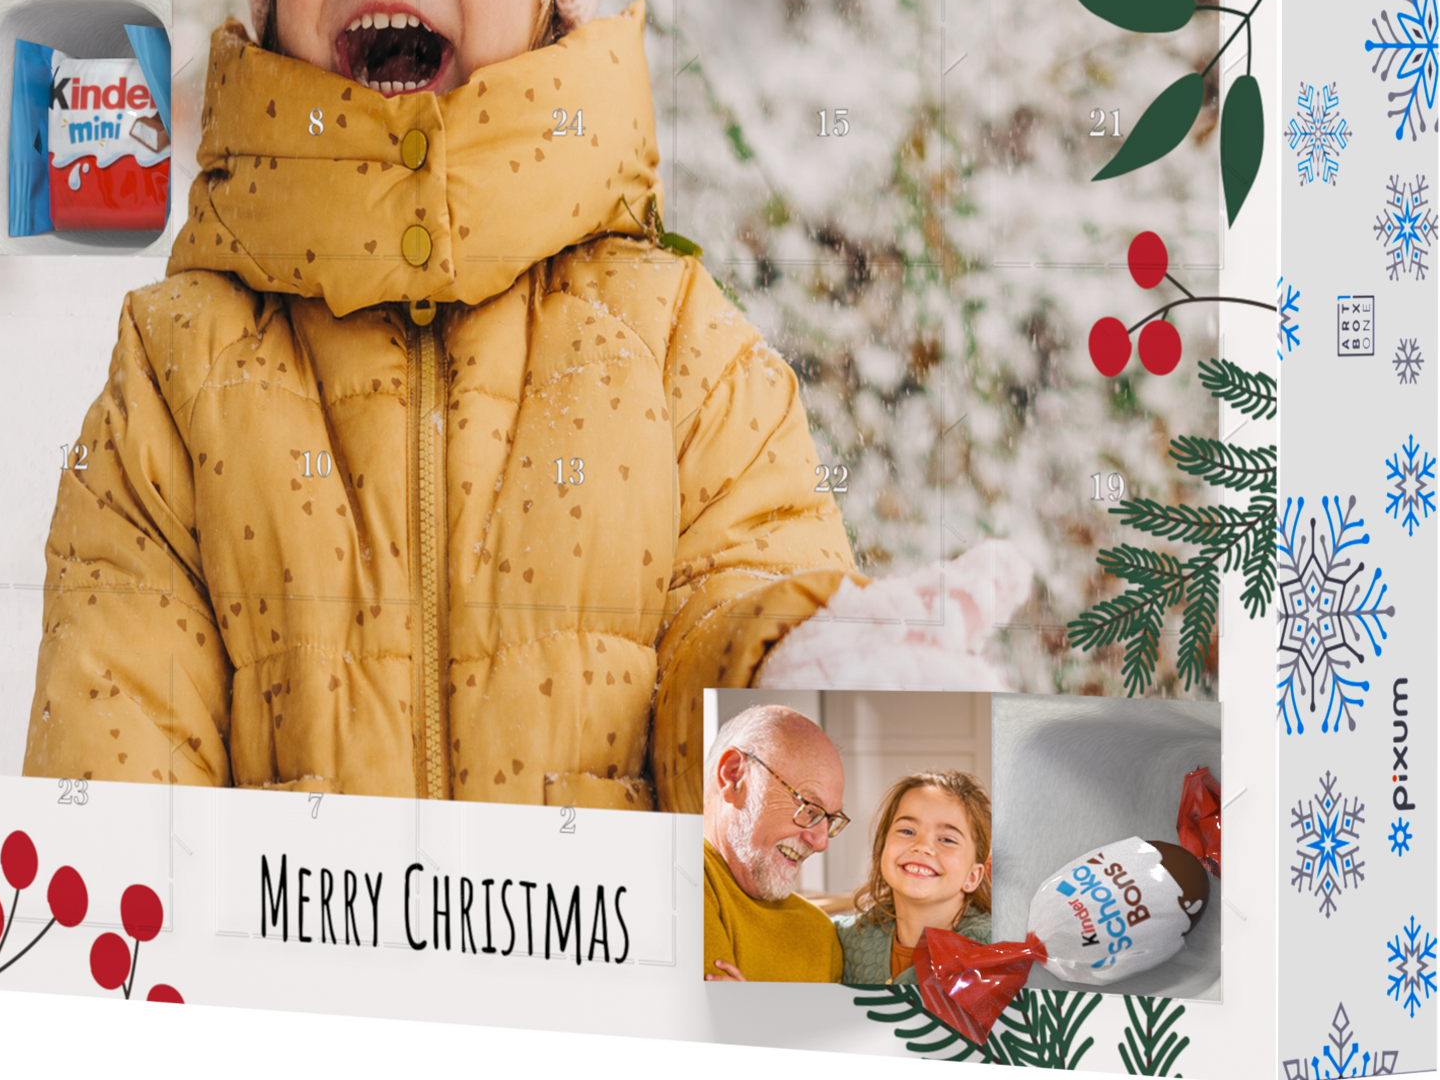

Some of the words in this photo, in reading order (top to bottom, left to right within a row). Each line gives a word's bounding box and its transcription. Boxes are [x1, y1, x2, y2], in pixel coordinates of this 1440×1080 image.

[68, 113, 123, 145] mini
[308, 108, 325, 136] 8
[551, 108, 586, 136] 24
[816, 108, 850, 137] 15
[1089, 107, 1124, 137] 21
[1341, 303, 1350, 350] ART
[1352, 303, 1360, 350] BOX
[1362, 303, 1371, 350] ONE
[60, 443, 89, 471] 12
[302, 450, 332, 478] 10
[553, 457, 586, 486] 13
[814, 464, 849, 493] 22
[1090, 472, 1126, 502] 19
[1393, 677, 1416, 811] pixum
[57, 778, 89, 806] 23
[308, 792, 324, 820] 7
[559, 805, 577, 834] 2
[1104, 862, 1151, 927] Bons
[1072, 865, 1133, 955] Schoko
